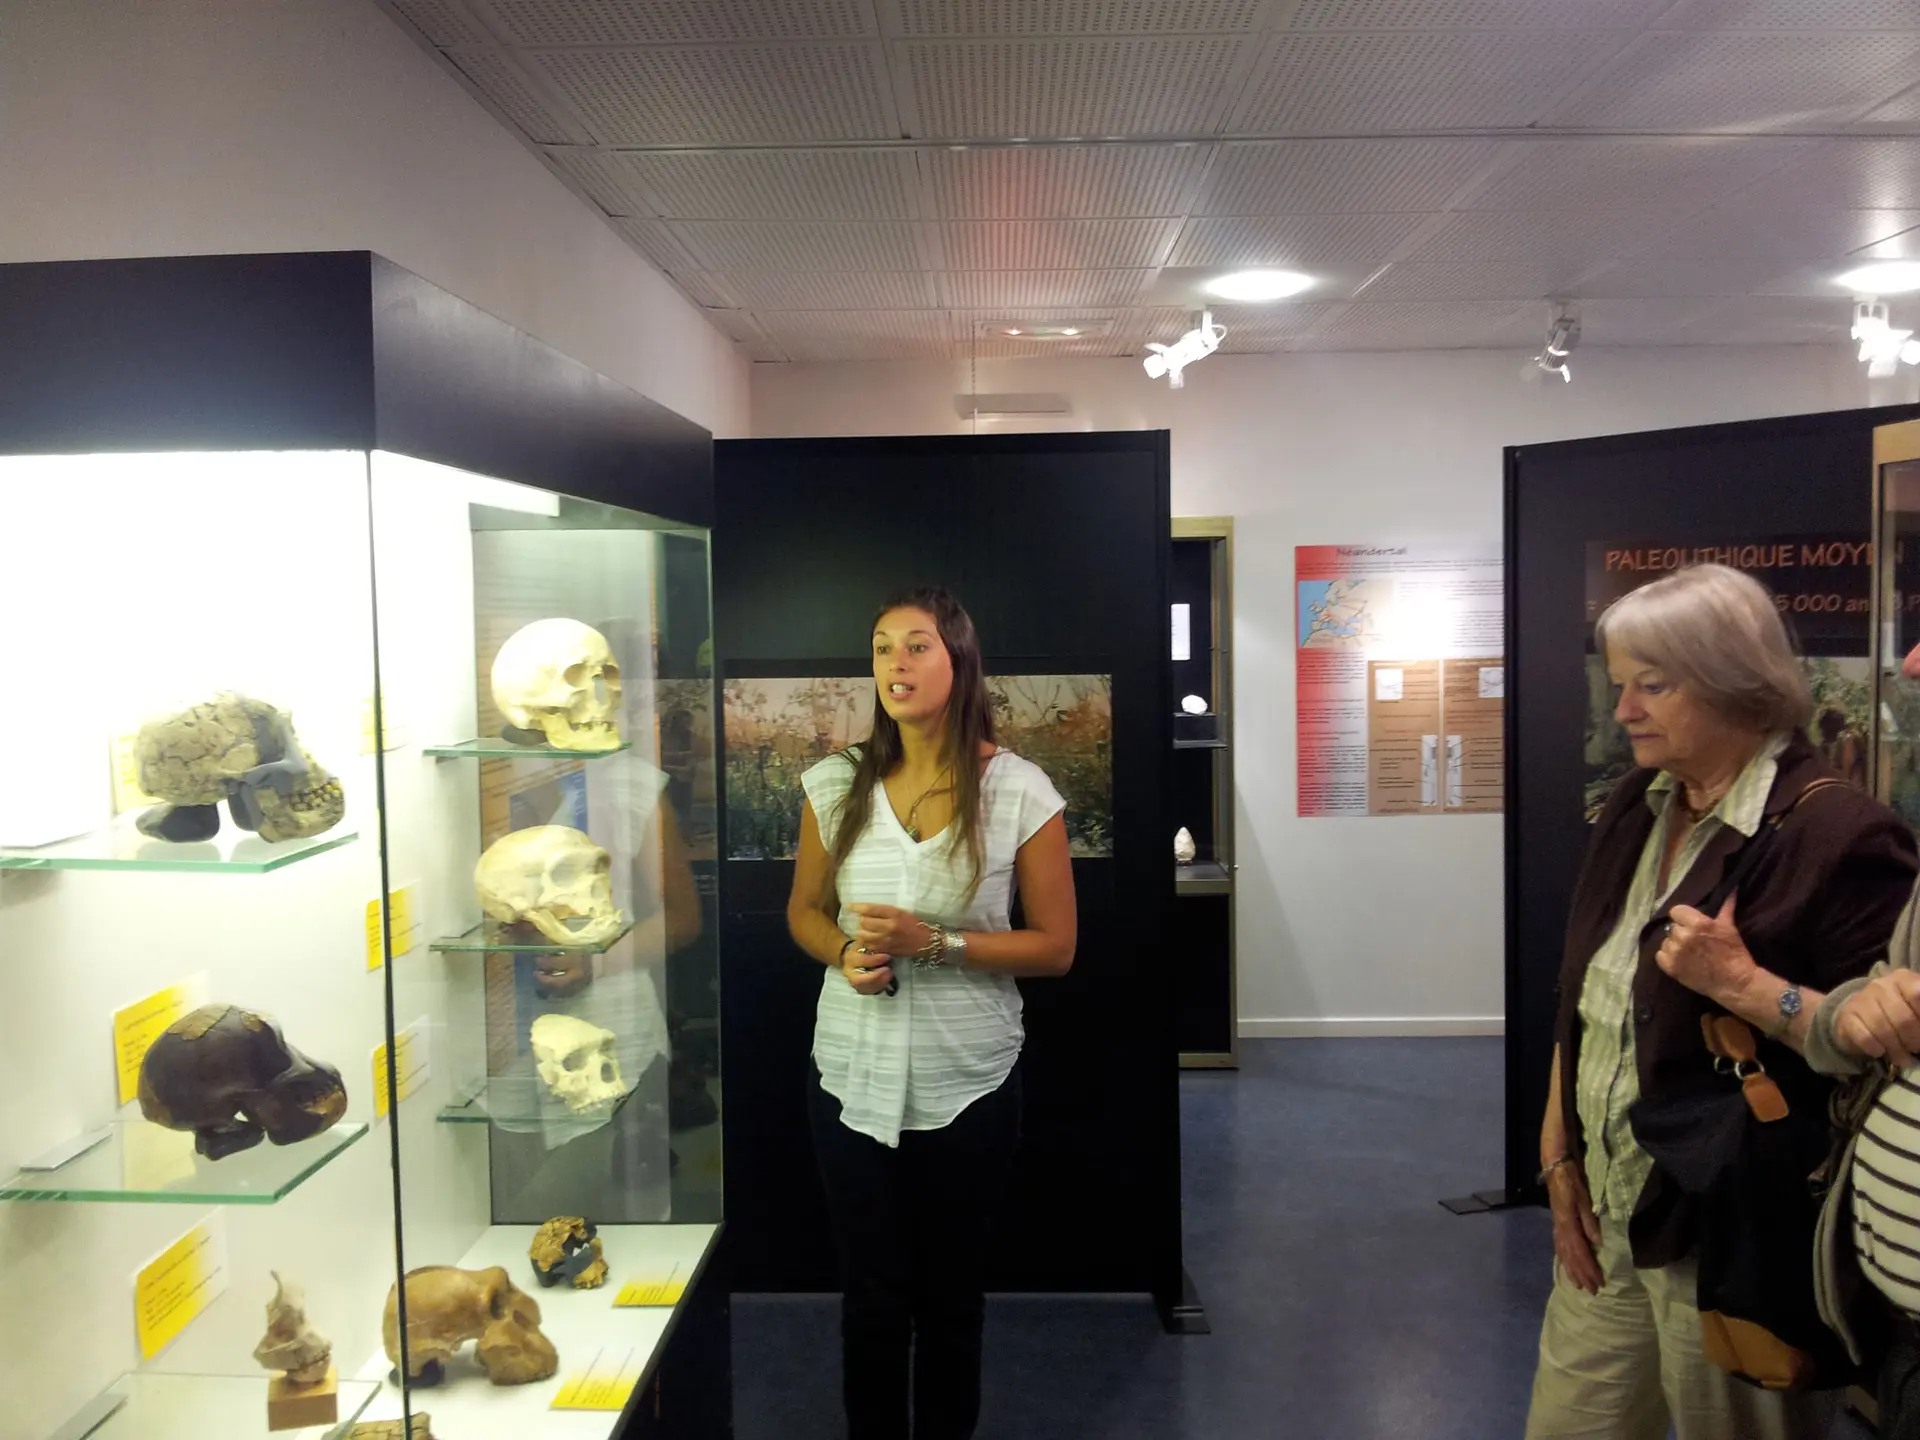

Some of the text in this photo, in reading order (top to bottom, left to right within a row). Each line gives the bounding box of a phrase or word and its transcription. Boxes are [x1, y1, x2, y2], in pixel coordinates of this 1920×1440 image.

[1801, 541, 1903, 567] MOY
[1793, 594, 1842, 612] 000
[1845, 598, 1874, 612] an
